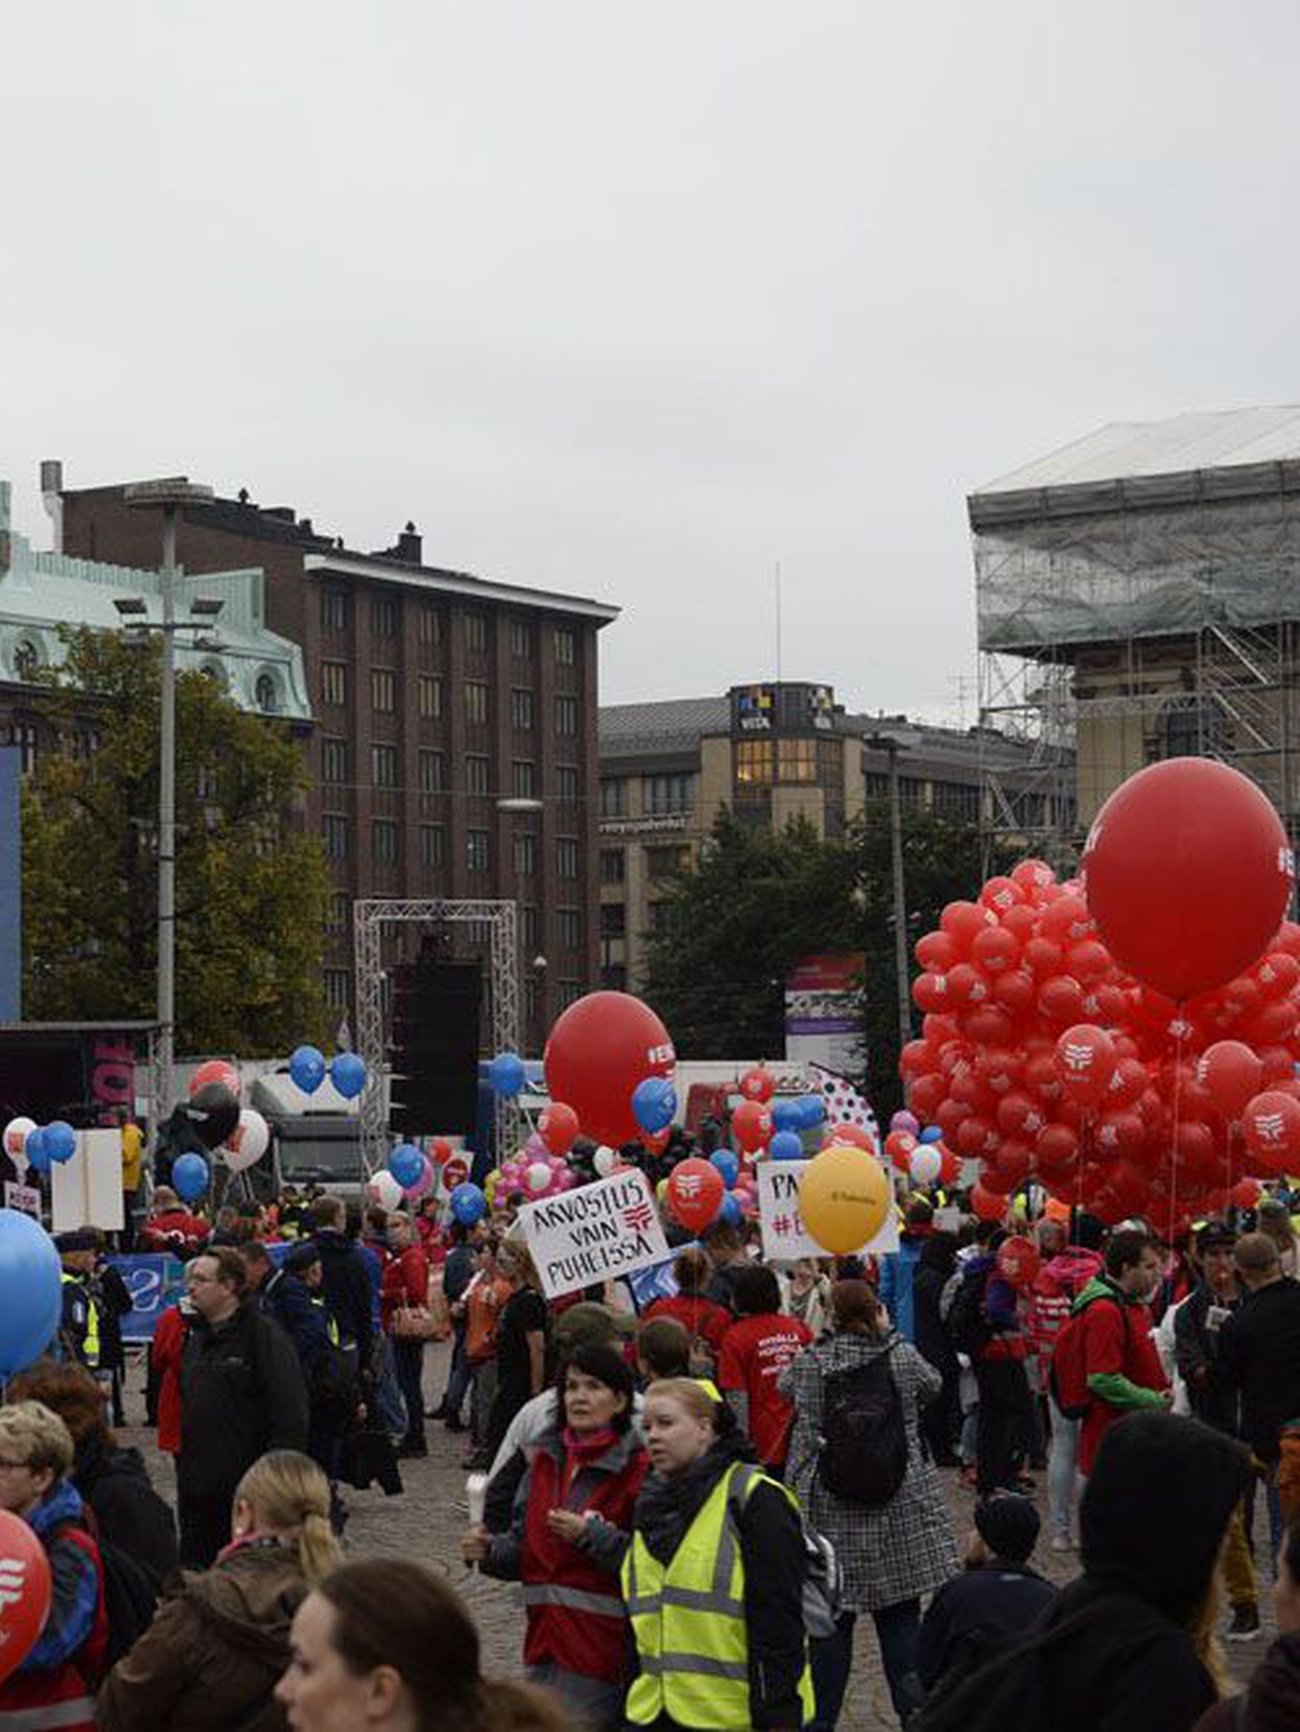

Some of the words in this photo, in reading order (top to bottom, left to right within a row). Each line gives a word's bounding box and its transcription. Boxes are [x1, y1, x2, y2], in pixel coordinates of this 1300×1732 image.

[532, 1179, 644, 1234] ARVOSTUS
[569, 1218, 619, 1247] VAIN
[547, 1234, 654, 1287] PUHEISSA
